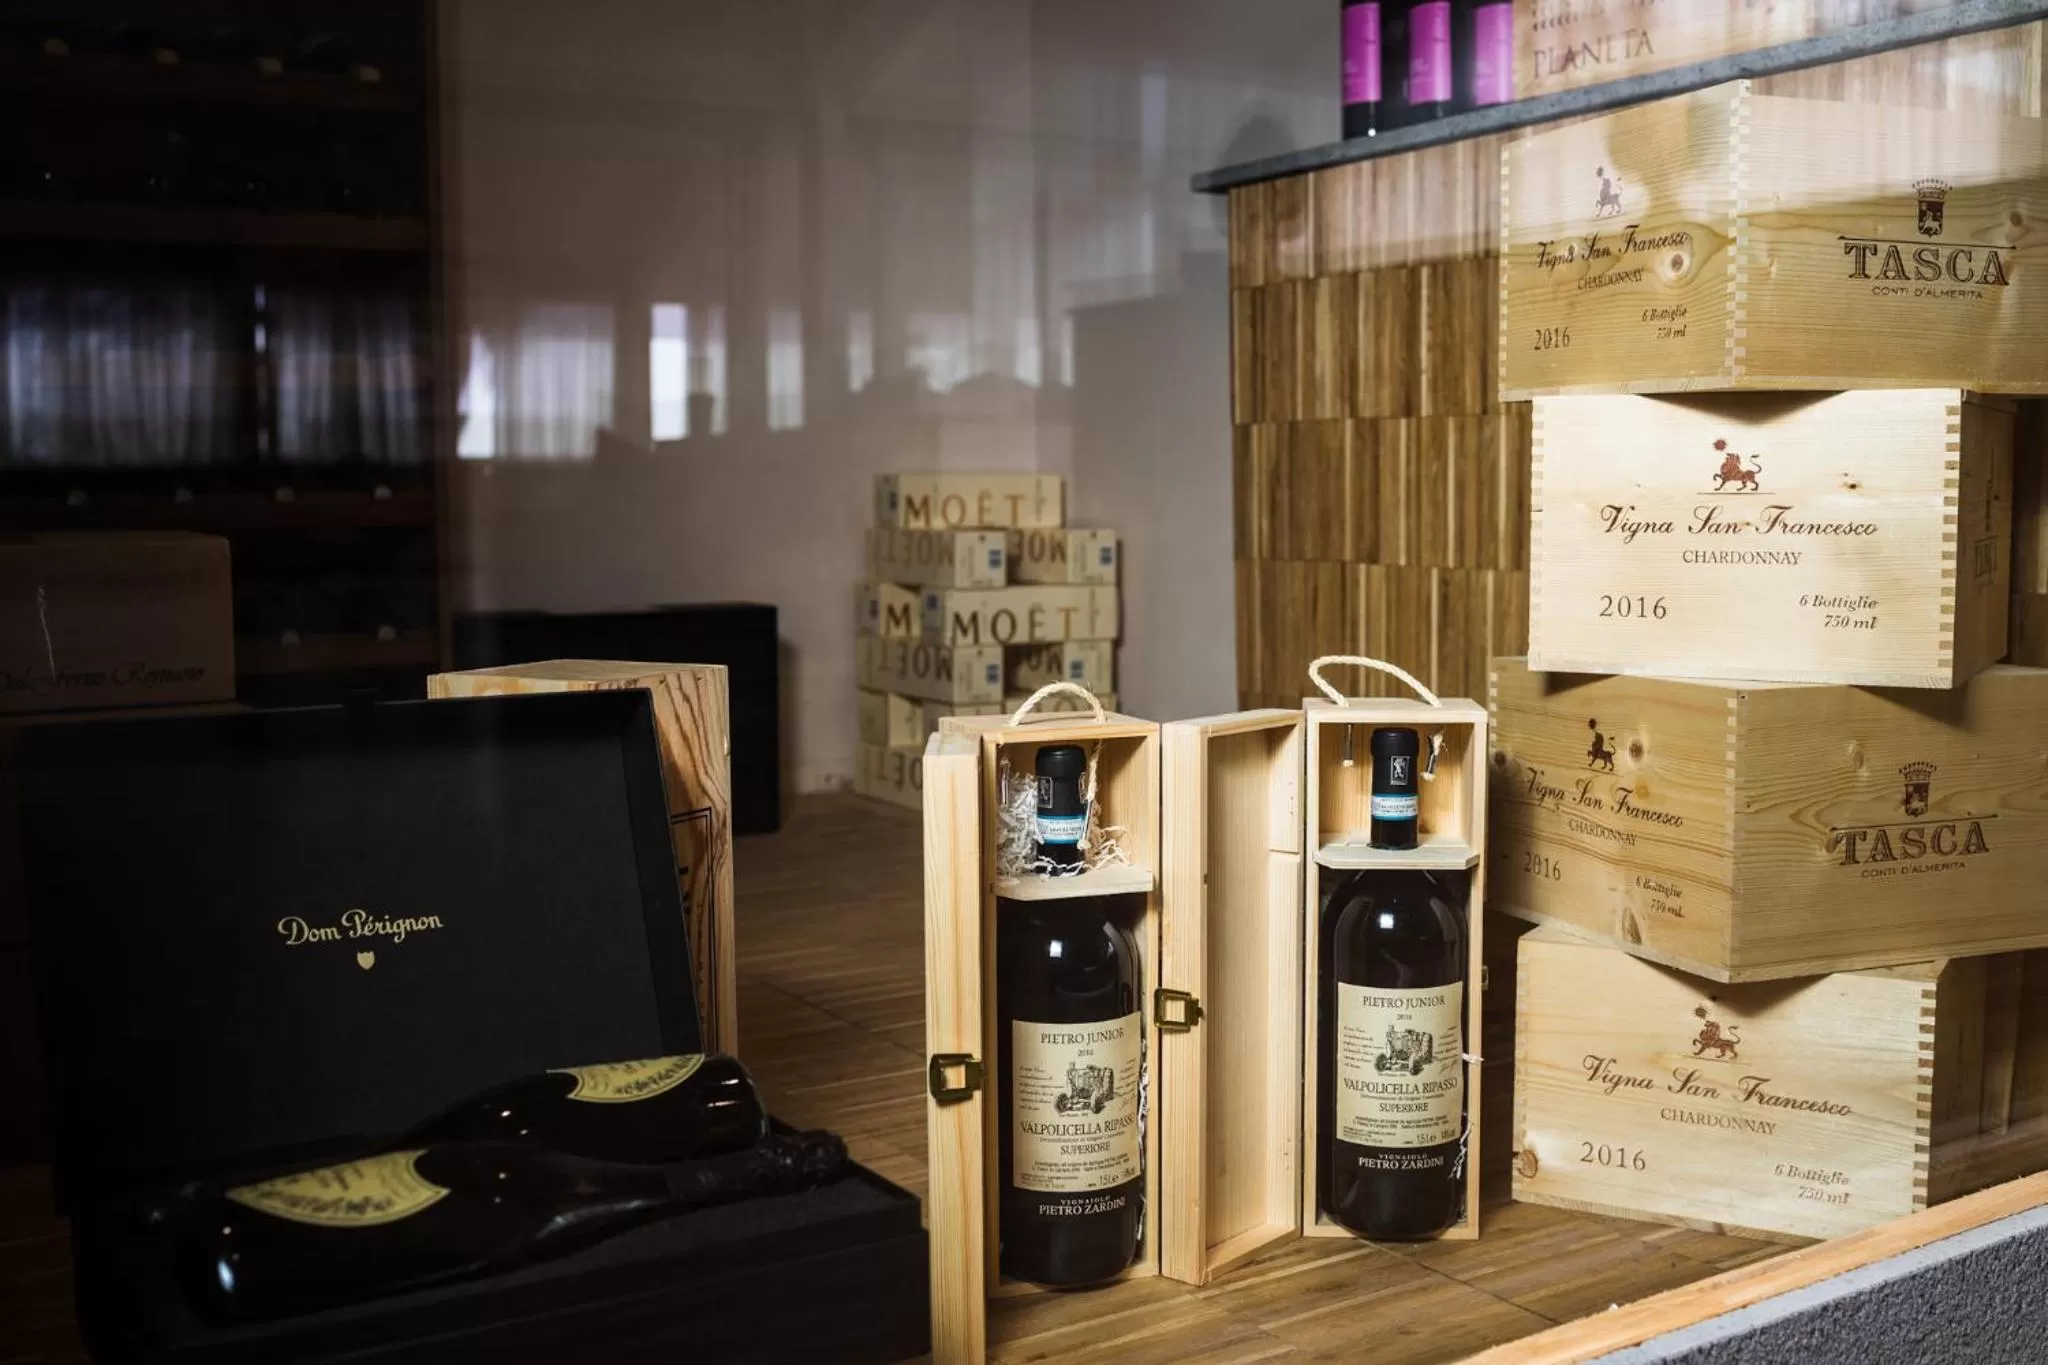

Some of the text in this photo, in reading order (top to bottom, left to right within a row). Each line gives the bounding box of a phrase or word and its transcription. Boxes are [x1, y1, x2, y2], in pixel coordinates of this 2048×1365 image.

[1533, 29, 1655, 78] PLANETA
[1536, 224, 1690, 274] Vigna San Francesco
[1843, 241, 2010, 286] TASCA
[1577, 267, 1644, 290] CHARDONNAY
[1871, 285, 1984, 300] CONTI D'ALMERITA
[1533, 327, 1571, 351] 2016
[1600, 503, 1879, 544] Vigna San Francesco
[1682, 549, 1803, 566] CHARDONNAY
[1599, 594, 1668, 620] 2016
[1799, 593, 1879, 612] 6 Bottiglie
[1823, 613, 1878, 630] 750 ml
[1526, 766, 1684, 828] Vigna San Francesco
[1568, 818, 1638, 847] CHARDONNAY
[1835, 821, 1990, 867] TASCA
[1523, 851, 1562, 881] 2016
[1861, 861, 1966, 879] CONTI D'ALMERITA
[277, 908, 444, 945] Dom Pérignon
[1363, 994, 1446, 1010] PIETRO JUNIOR
[1040, 1027, 1125, 1046] PIETRO JUNIOR
[1343, 1076, 1458, 1094] VALPOLICELLA RIPASSO
[1582, 1053, 1852, 1117] Vigna San Francesco
[1379, 1102, 1429, 1113] SUPERIORE
[1020, 1120, 1102, 1136] VALPOLICELLA
[1660, 1107, 1778, 1136] CHARDONNAY
[1060, 1141, 1111, 1155] SUPERIORE
[1580, 1140, 1647, 1171] 2016
[1358, 1156, 1445, 1170] PIETRO ZARDINI
[1775, 1163, 1851, 1187] 6 Bottiglie
[1797, 1186, 1823, 1201] 750
[1039, 1196, 1126, 1216] PIETRO ZARDINI
